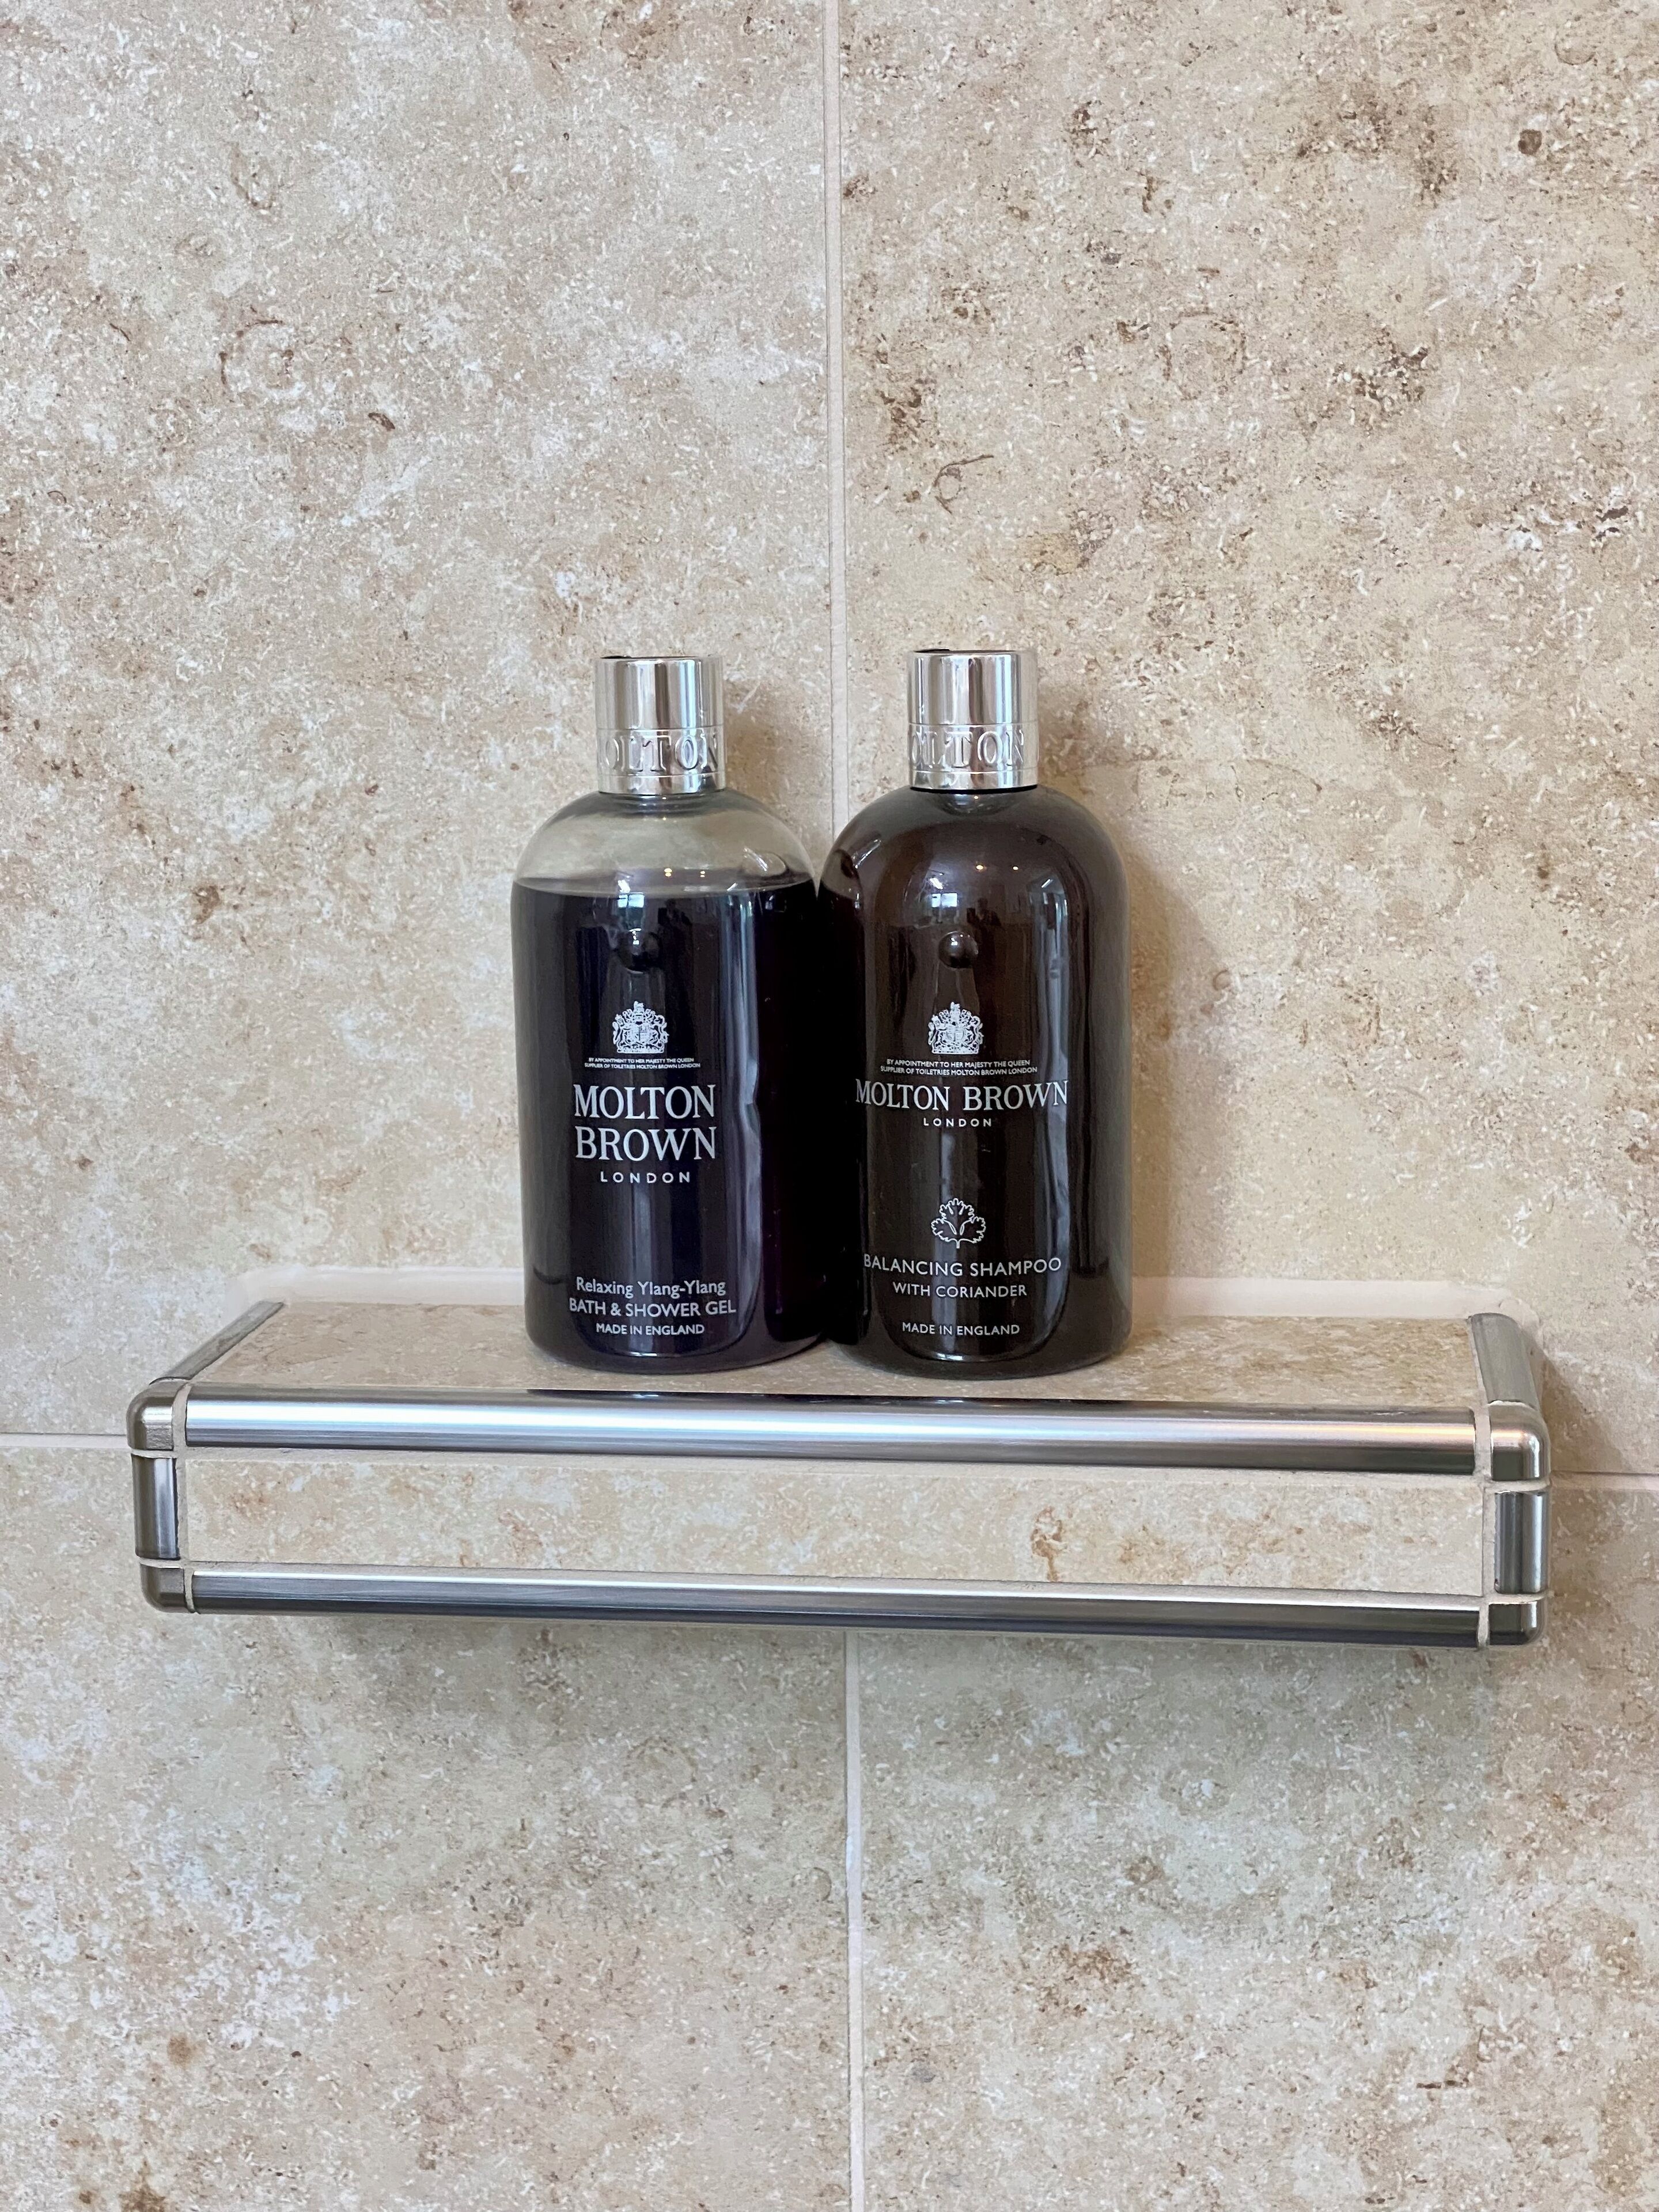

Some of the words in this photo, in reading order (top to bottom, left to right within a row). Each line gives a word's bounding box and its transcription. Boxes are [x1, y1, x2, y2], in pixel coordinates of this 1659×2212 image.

[603, 733, 719, 773] OLTON
[910, 729, 1025, 769] OLTON
[880, 1065, 905, 1074] SUPPLIER
[1008, 1066, 1037, 1074] LONDON
[894, 1059, 939, 1067] APPOINTMENT
[573, 1084, 716, 1119] MOLTON
[855, 1078, 950, 1111] MOLTON
[963, 1080, 1068, 1111] BROWN
[923, 1118, 992, 1127] LONDON
[575, 1126, 717, 1161] BROWN
[600, 1171, 690, 1184] LONDON
[864, 1253, 963, 1277] BALANCING
[970, 1257, 1062, 1277] SHAMPOO
[576, 1276, 634, 1299] Relaxing
[637, 1279, 726, 1300] Ylang-Ylang
[893, 1282, 930, 1296] WITH
[935, 1285, 1027, 1298] CORIANDER
[569, 1297, 607, 1315] BATH
[610, 1302, 622, 1317] &
[626, 1302, 702, 1317] SHOWER
[704, 1299, 737, 1316] GEL
[596, 1323, 628, 1335] MADE
[630, 1325, 642, 1335] IN
[645, 1324, 705, 1336] ENGLAND
[902, 1322, 935, 1334] MADE
[939, 1325, 952, 1336] IN
[957, 1324, 1020, 1336] ENGLAND
